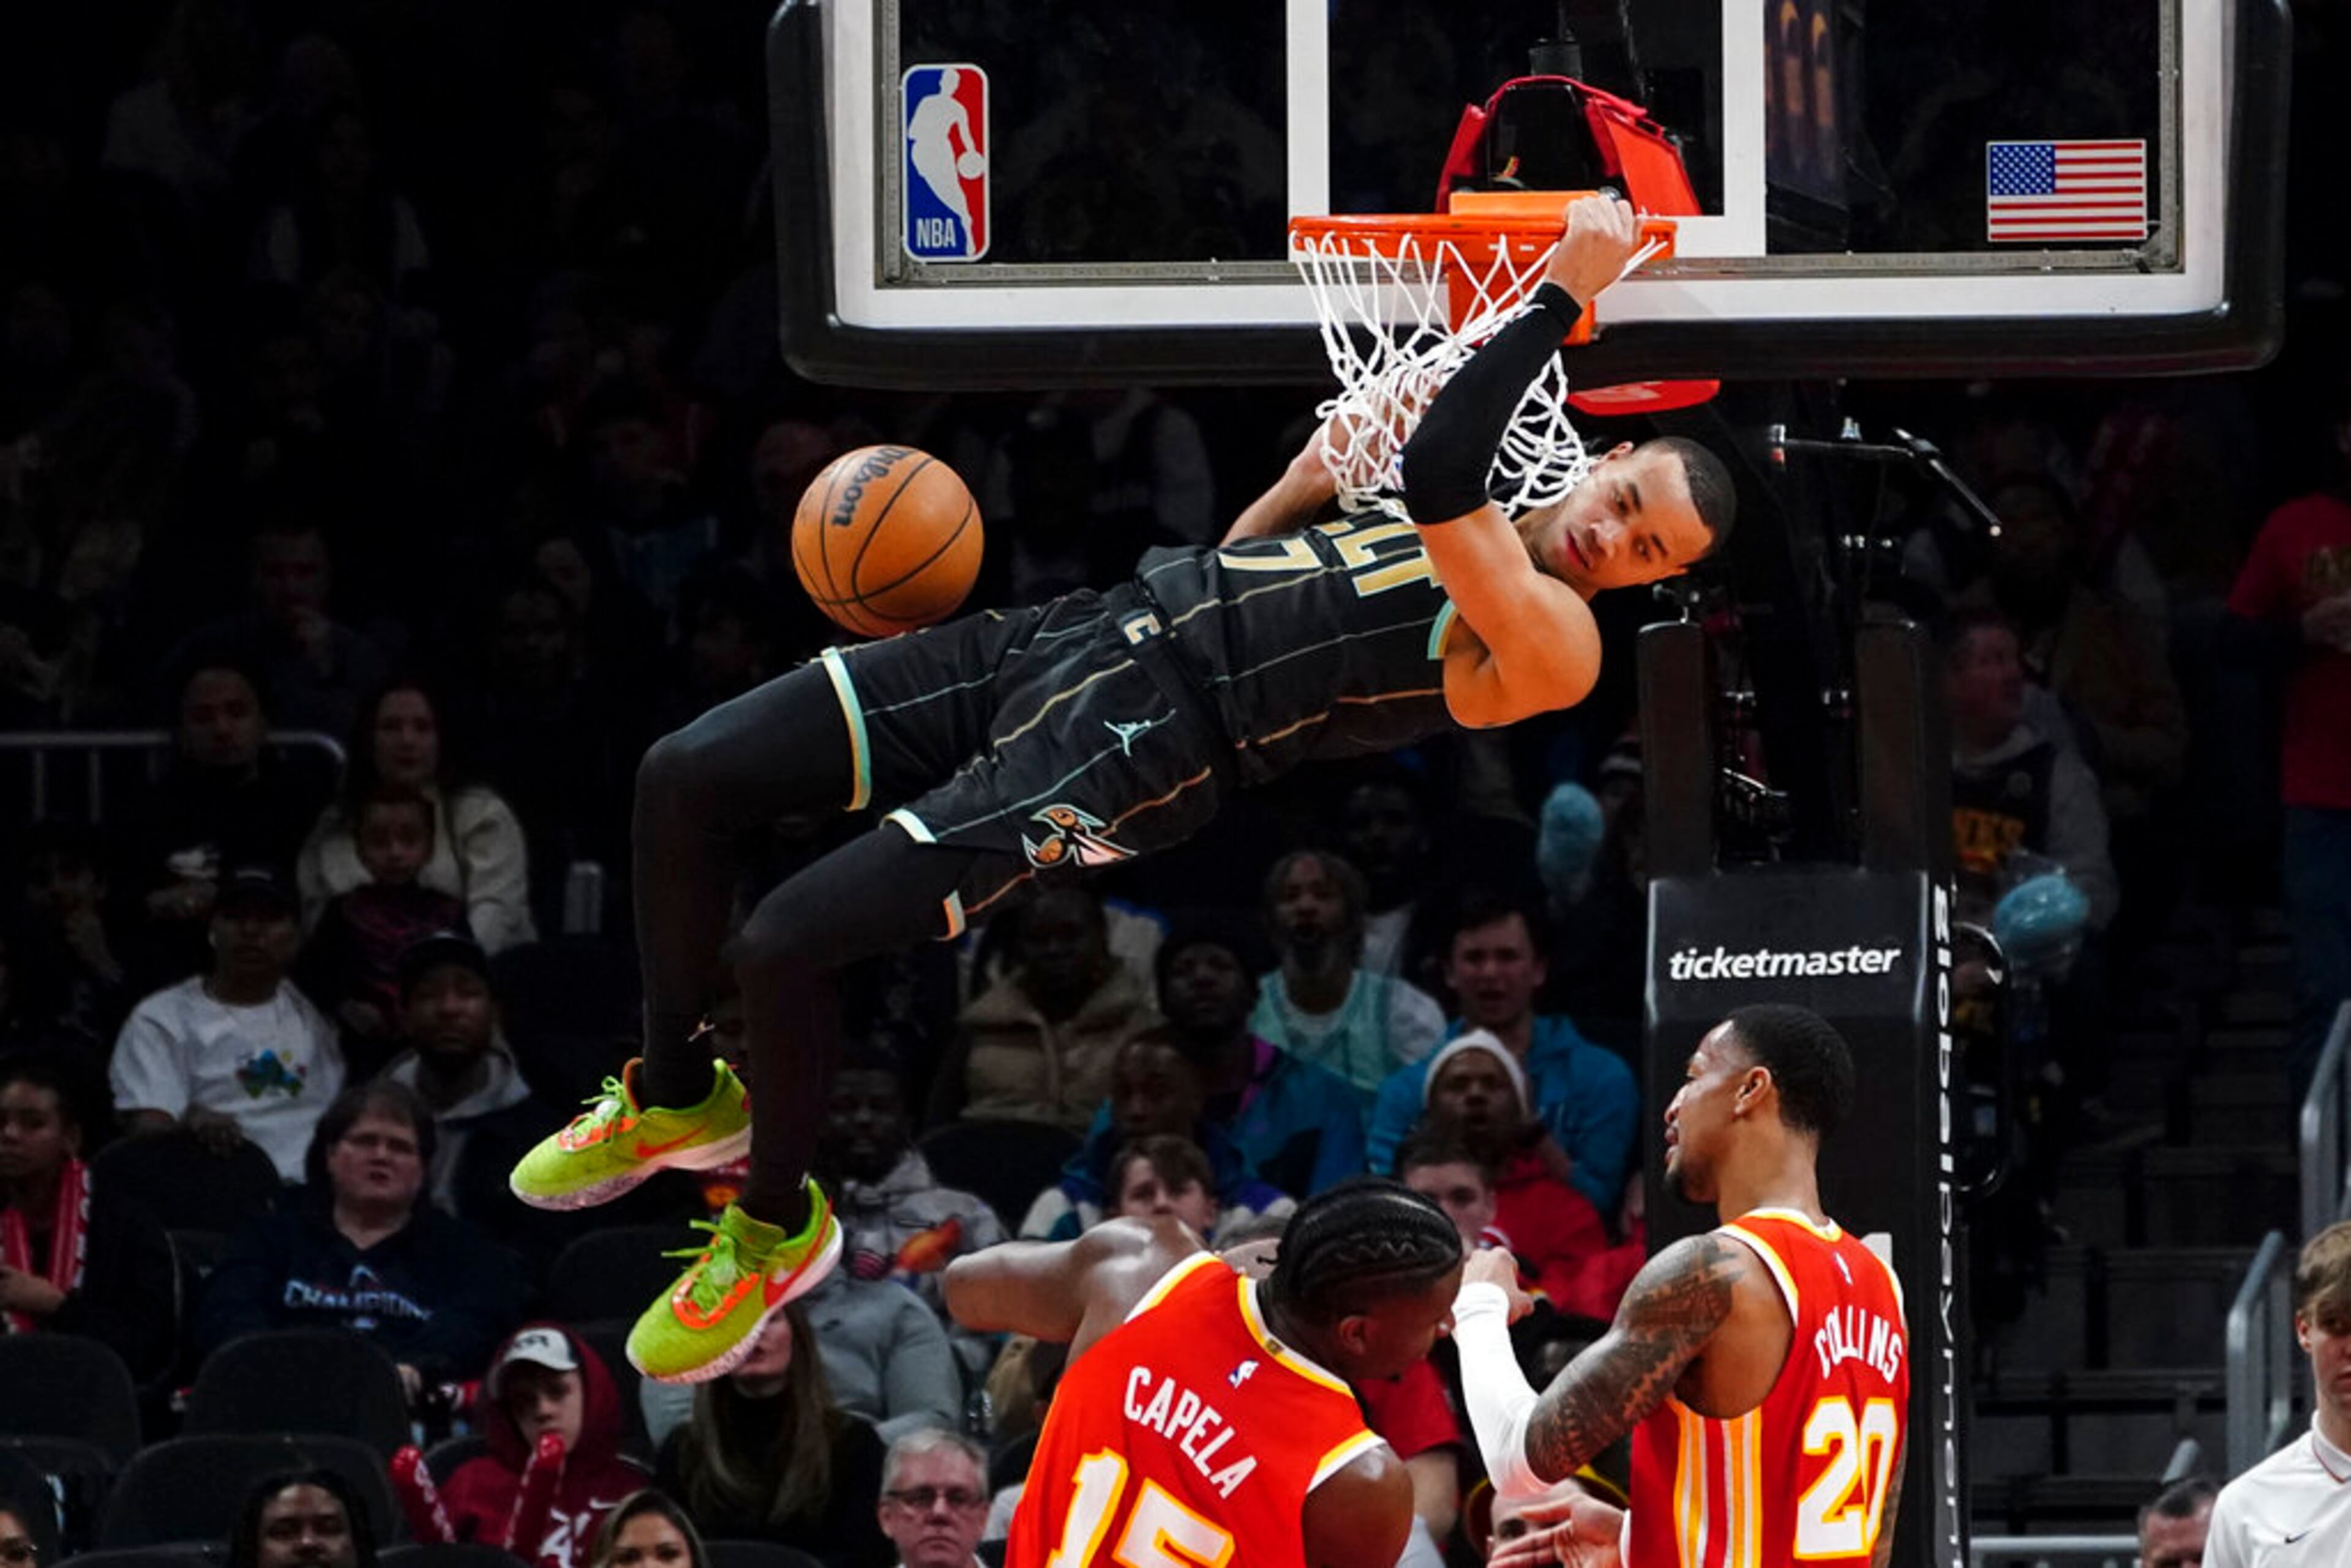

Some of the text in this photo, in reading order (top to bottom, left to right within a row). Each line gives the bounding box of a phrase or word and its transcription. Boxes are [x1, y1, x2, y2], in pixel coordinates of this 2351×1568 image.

[917, 217, 956, 249] NBA
[1218, 536, 1324, 571] 7
[1312, 520, 1446, 598] LT
[1668, 945, 1901, 980] ticketmaster
[1815, 1305, 1903, 1383] COLLINS
[1123, 1366, 1258, 1499] CAPELA
[1794, 1396, 1899, 1559] 20
